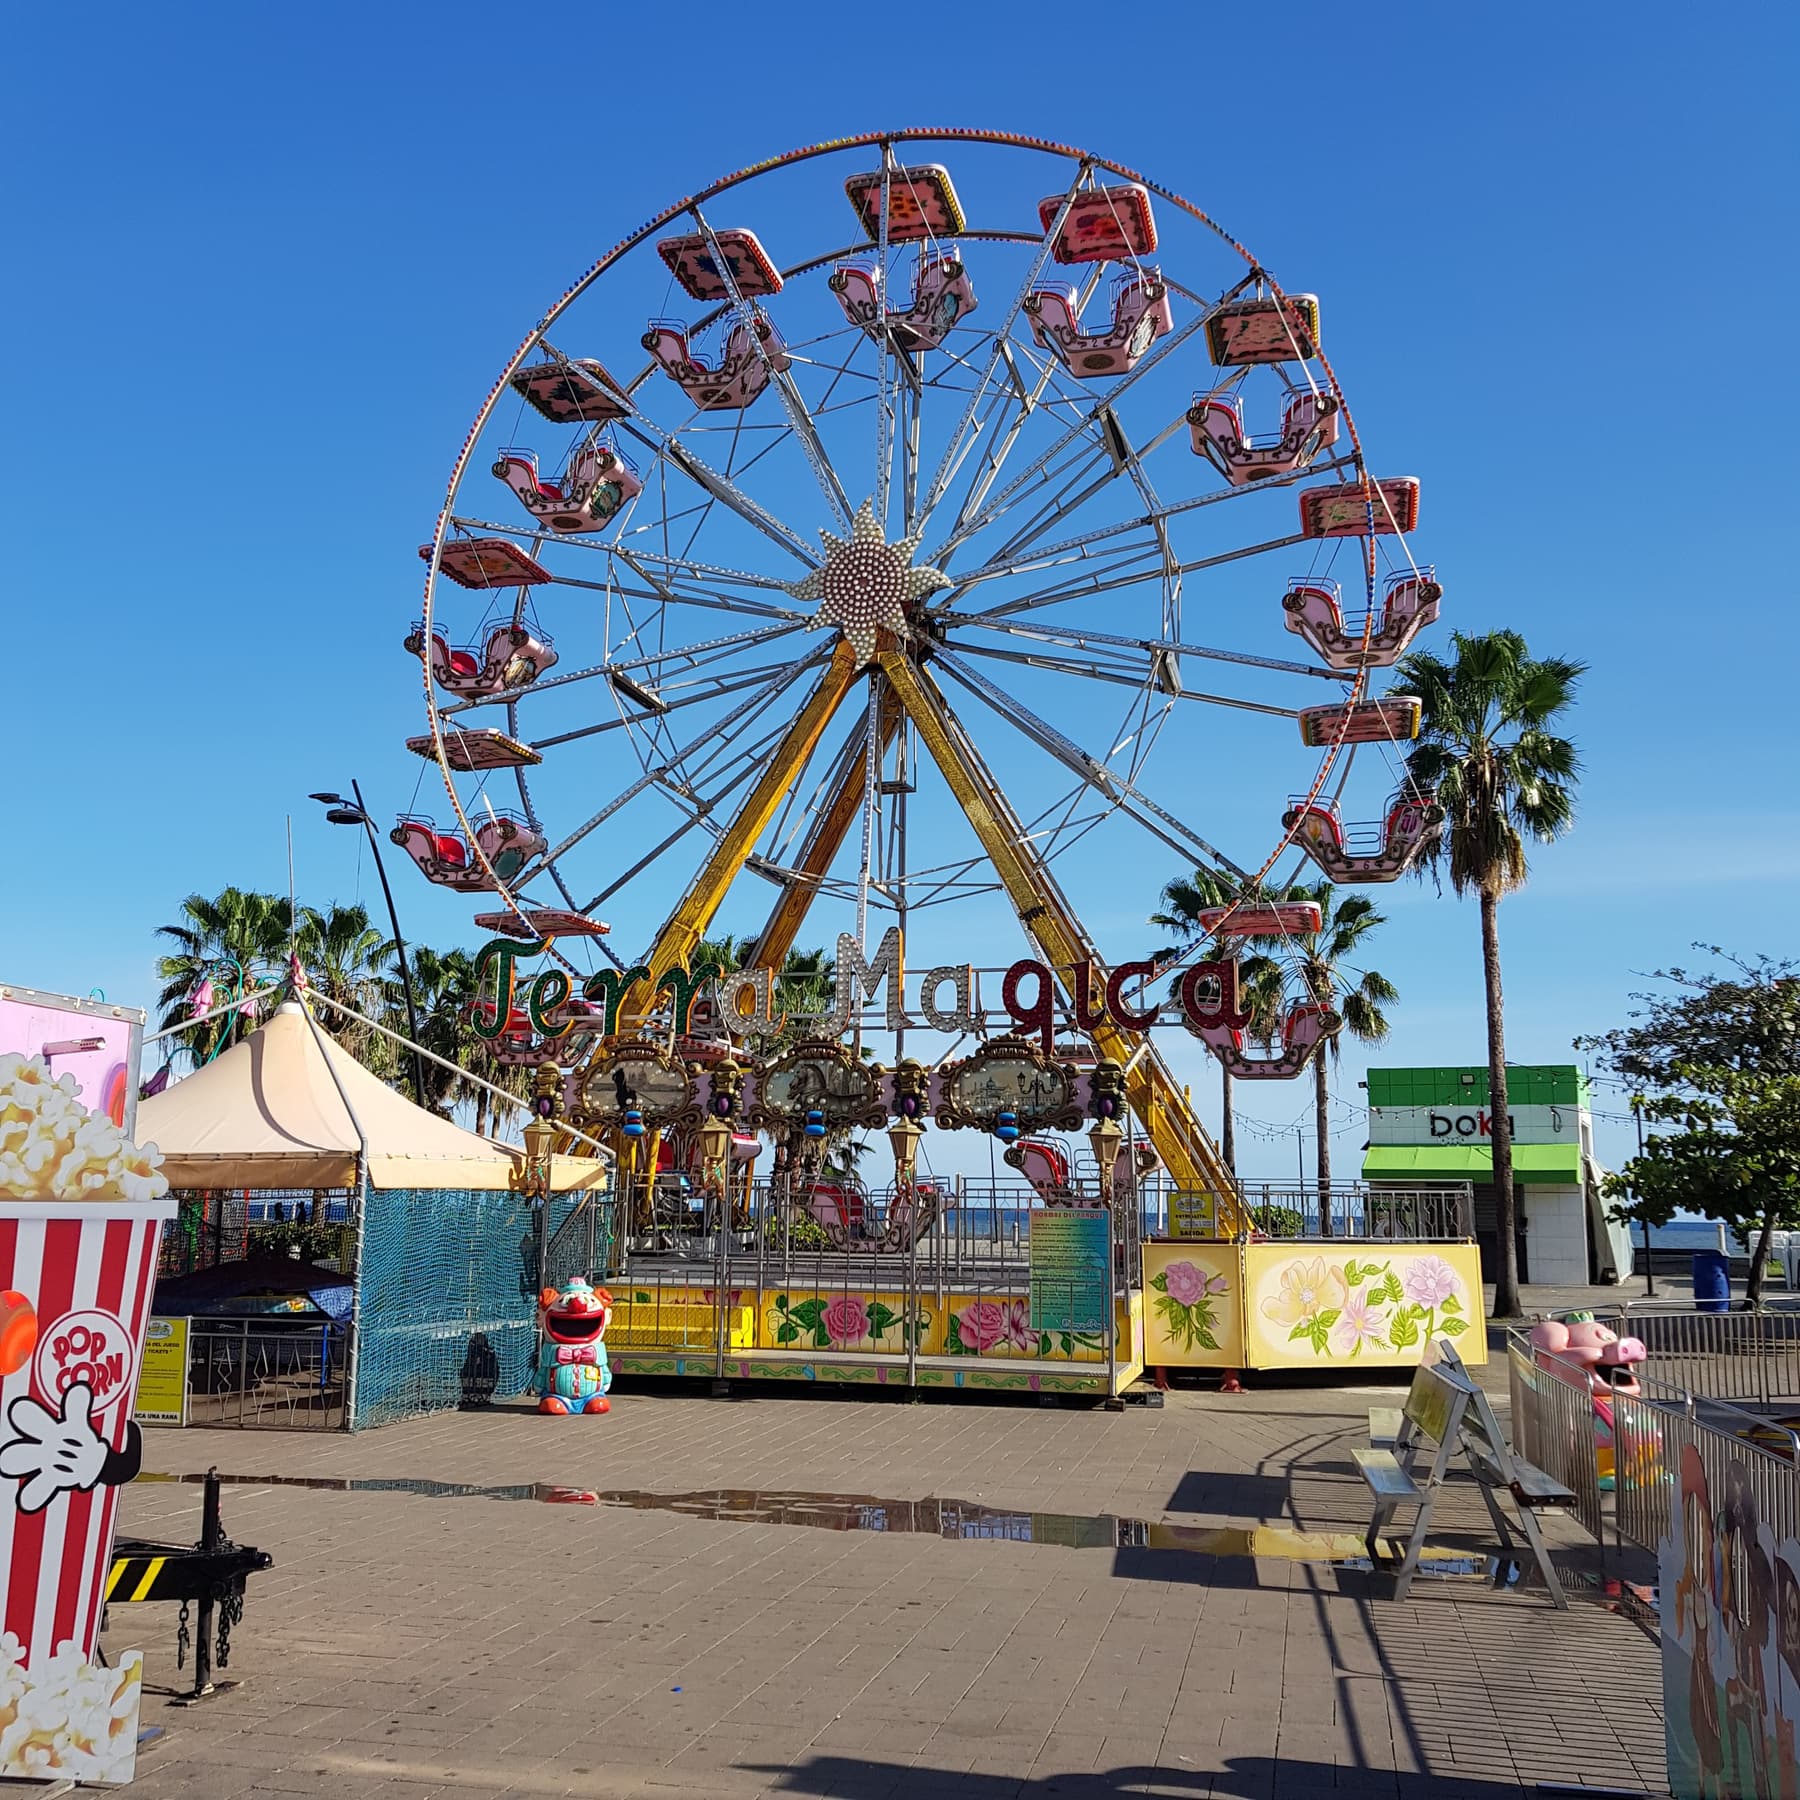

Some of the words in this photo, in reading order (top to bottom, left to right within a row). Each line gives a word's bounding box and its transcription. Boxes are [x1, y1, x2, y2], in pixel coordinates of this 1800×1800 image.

[1091, 338, 1098, 348] 2
[552, 503, 558, 513] 5
[1363, 859, 1370, 870] 6
[470, 935, 787, 1039] Terra
[808, 926, 1254, 1056] Magica
[1259, 1064, 1266, 1075] 5
[52, 1325, 107, 1368] POP
[56, 1353, 123, 1397] CORN
